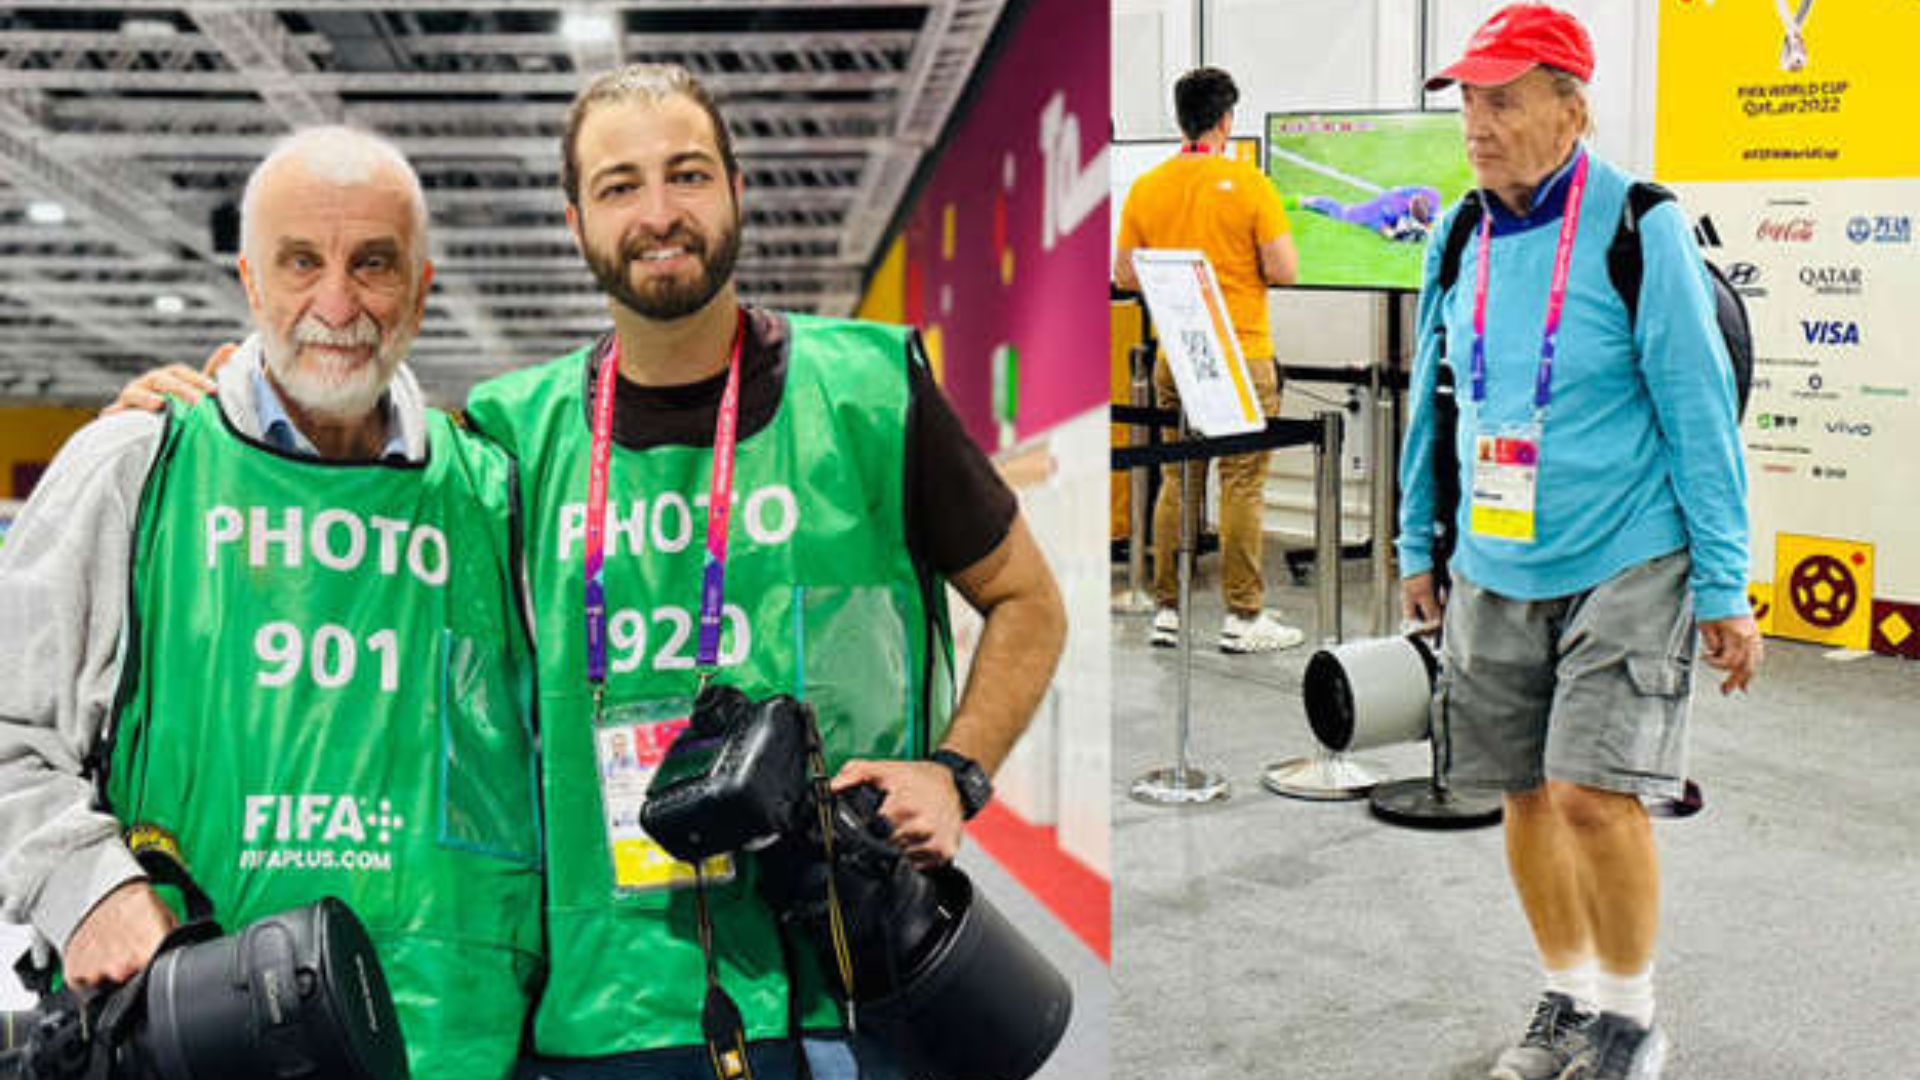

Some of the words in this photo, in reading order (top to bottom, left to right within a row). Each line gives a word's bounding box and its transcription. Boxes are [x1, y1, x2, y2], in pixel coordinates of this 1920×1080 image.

[1821, 81, 1848, 94] CUP
[1800, 267, 1863, 285] QATAR
[1801, 322, 1860, 344] VISA
[1824, 421, 1872, 436] vivo
[206, 505, 449, 586] PHOTO
[608, 604, 752, 673] 920
[254, 621, 399, 692] 901
